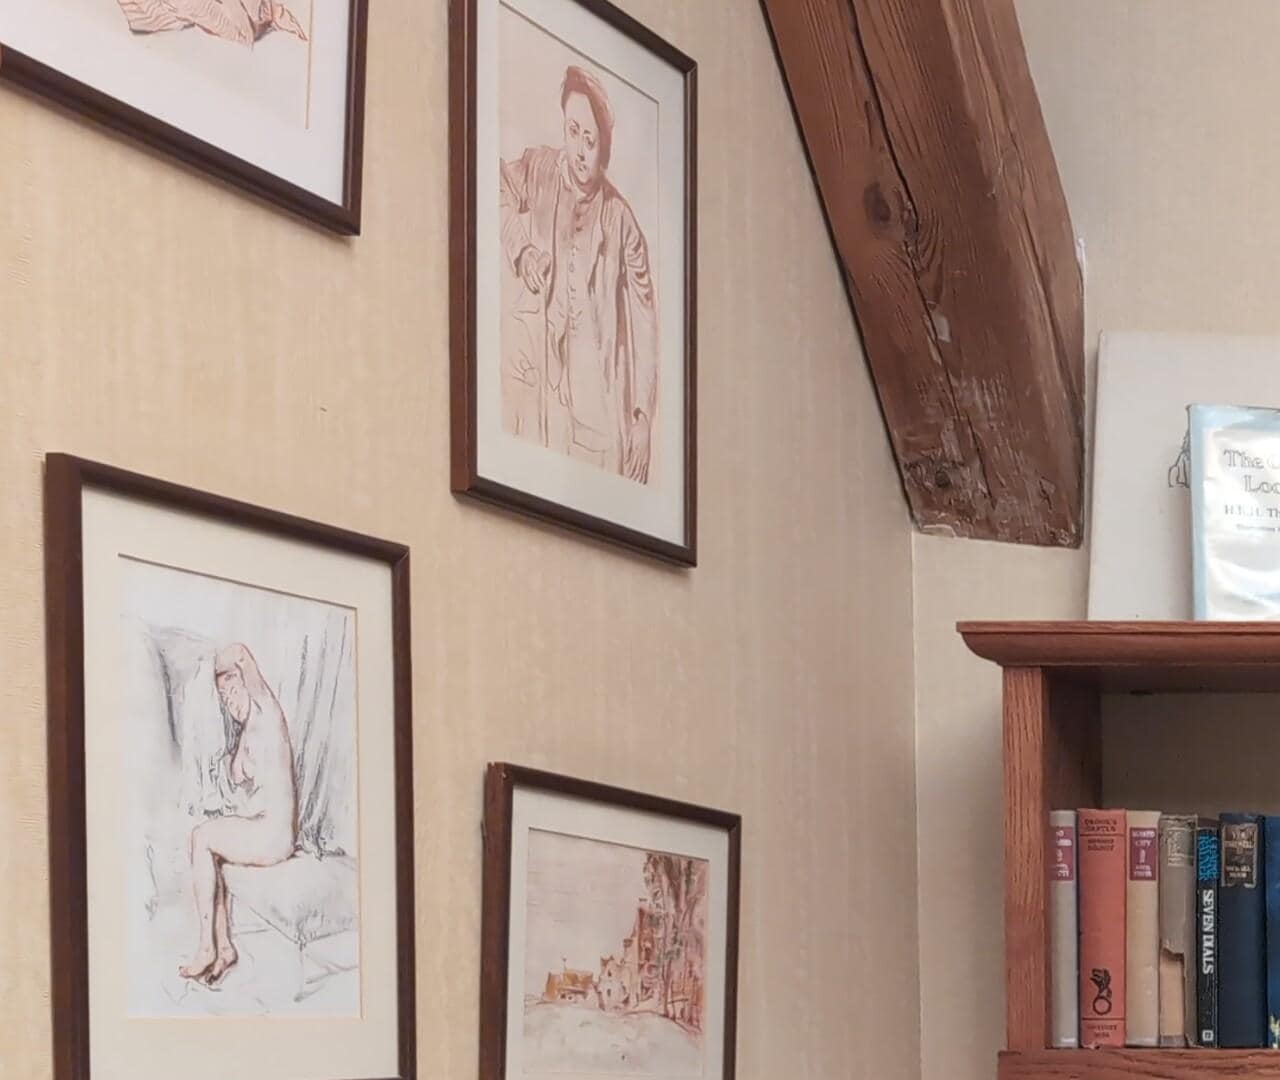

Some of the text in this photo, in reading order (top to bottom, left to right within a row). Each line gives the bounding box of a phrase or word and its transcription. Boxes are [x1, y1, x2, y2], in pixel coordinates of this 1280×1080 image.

[1223, 448, 1264, 470] The
[1202, 889, 1214, 975] SEVEN DIALS
